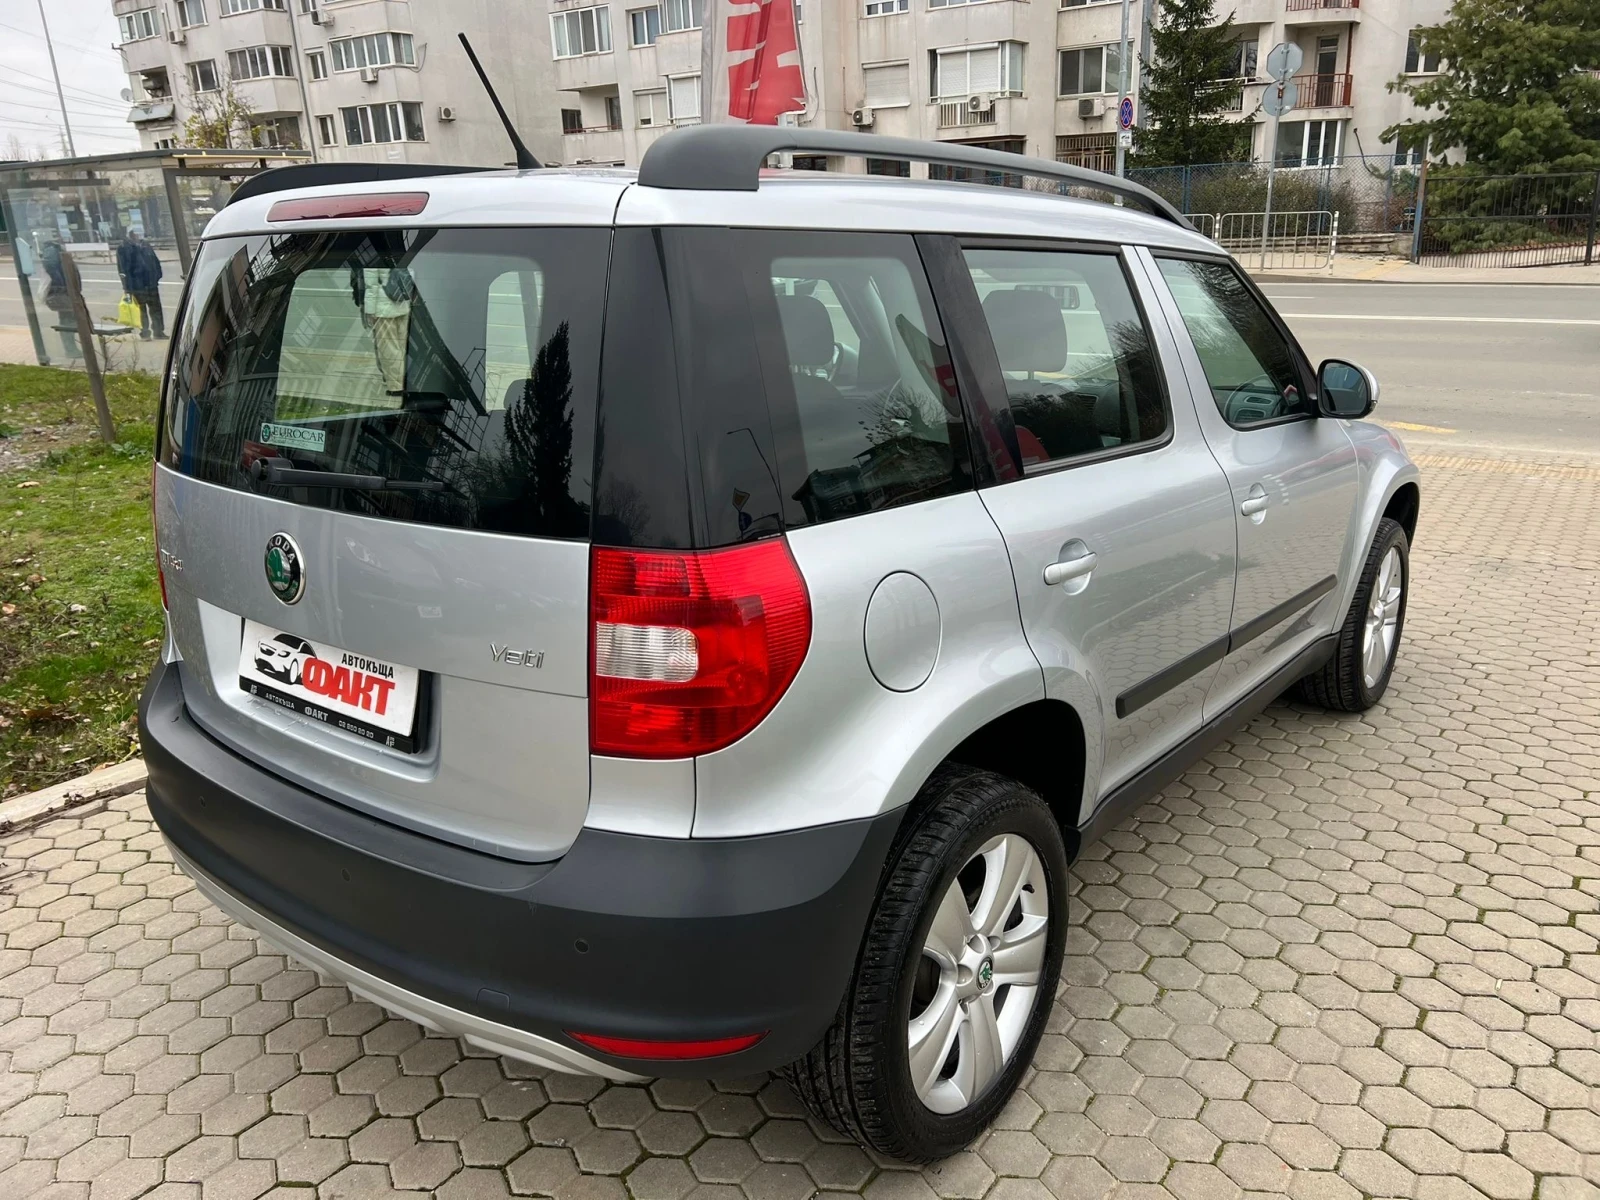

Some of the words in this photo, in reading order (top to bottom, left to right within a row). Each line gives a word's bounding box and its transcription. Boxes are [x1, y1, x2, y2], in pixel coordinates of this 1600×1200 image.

[272, 425, 324, 442] EUROCAR
[341, 653, 394, 679] АВТОКЪЩА
[490, 643, 545, 669] Yeti
[302, 657, 396, 716] ФАКТ
[304, 706, 329, 721] ФАКТ
